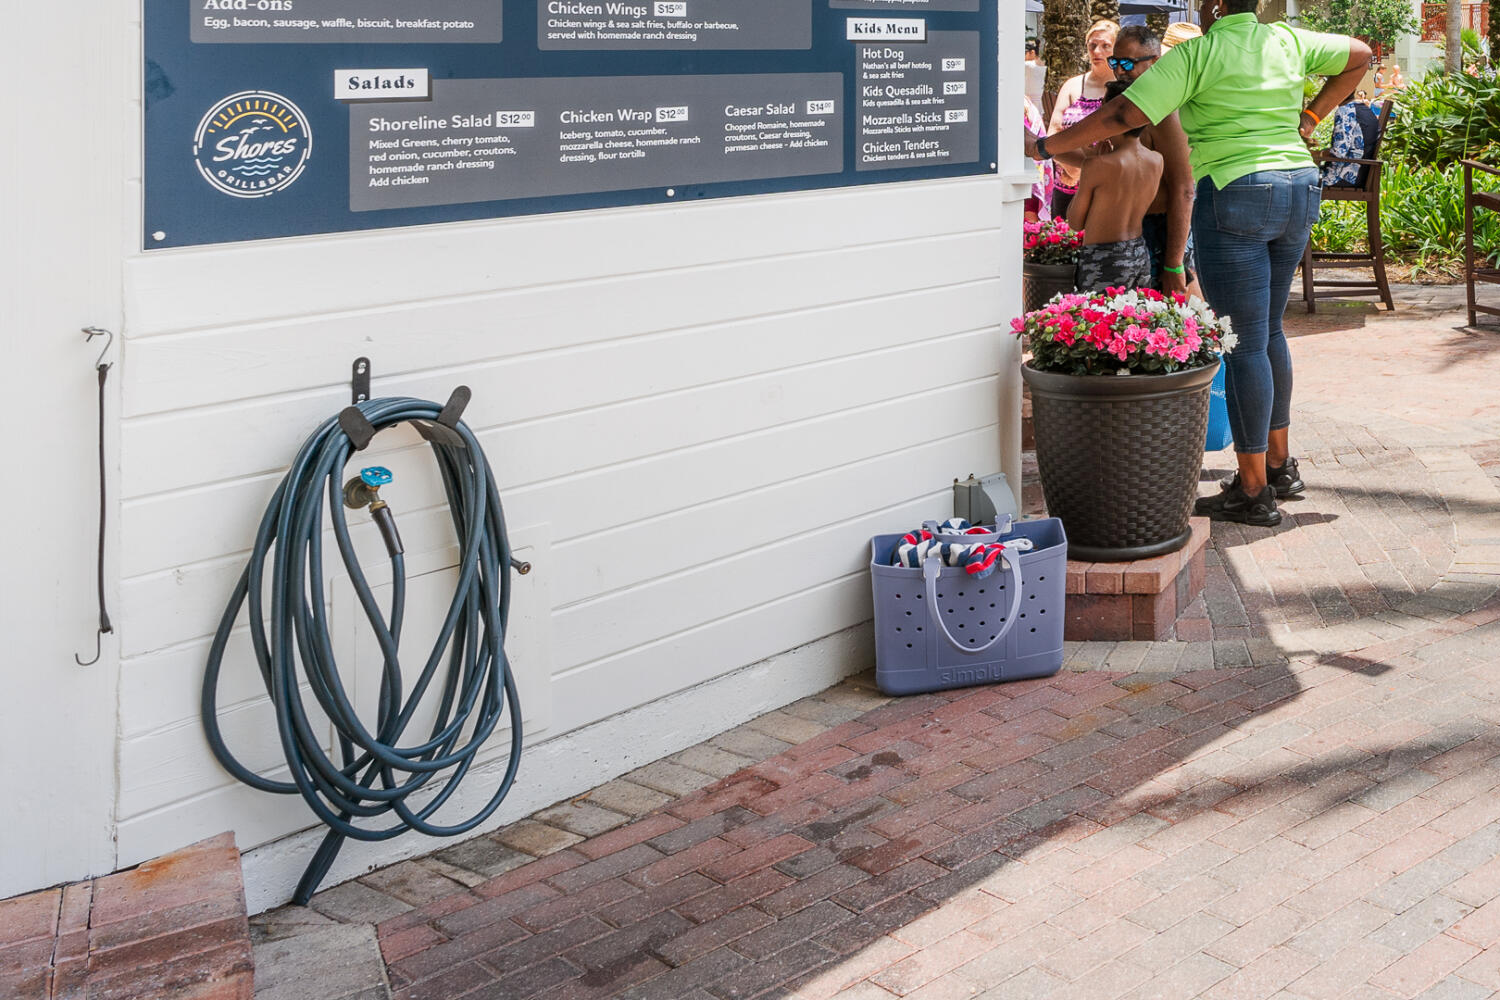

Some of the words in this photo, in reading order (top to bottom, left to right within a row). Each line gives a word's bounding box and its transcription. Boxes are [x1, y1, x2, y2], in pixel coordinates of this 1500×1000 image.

[547, 0, 603, 15] Chicken
[605, 2, 647, 19] Wings
[395, 18, 442, 29] breakfast
[442, 20, 474, 31] potato
[547, 18, 582, 28] Chicken
[582, 18, 607, 31] wings
[607, 19, 615, 28] &
[615, 21, 630, 29] sea
[630, 19, 646, 29] salt
[666, 20, 693, 29] buffalo
[854, 22, 882, 34] Kids
[885, 23, 918, 34] Menu
[862, 47, 882, 59] Hot
[883, 47, 904, 62] Dog
[348, 74, 415, 90] Salads
[862, 84, 883, 97] Kids
[884, 83, 933, 99] Quesadilla
[559, 109, 614, 124] Chicken
[616, 108, 652, 123] Wrap
[724, 104, 764, 117] Caesar
[765, 102, 795, 115] Salad
[368, 115, 447, 132] Shoreline
[451, 113, 492, 129] Salad
[862, 112, 913, 126] Mozzarella
[914, 111, 942, 123] Sticks
[213, 133, 297, 162] Shores
[368, 138, 400, 150] Mixed
[440, 136, 474, 147] cherry
[862, 141, 901, 154] Chicken
[902, 138, 940, 151] Tenders
[368, 151, 387, 162] red
[368, 162, 425, 175] homemade
[426, 160, 455, 171] ranch
[455, 157, 495, 170] dressing
[368, 176, 390, 187] Add
[391, 174, 429, 186] chicken
